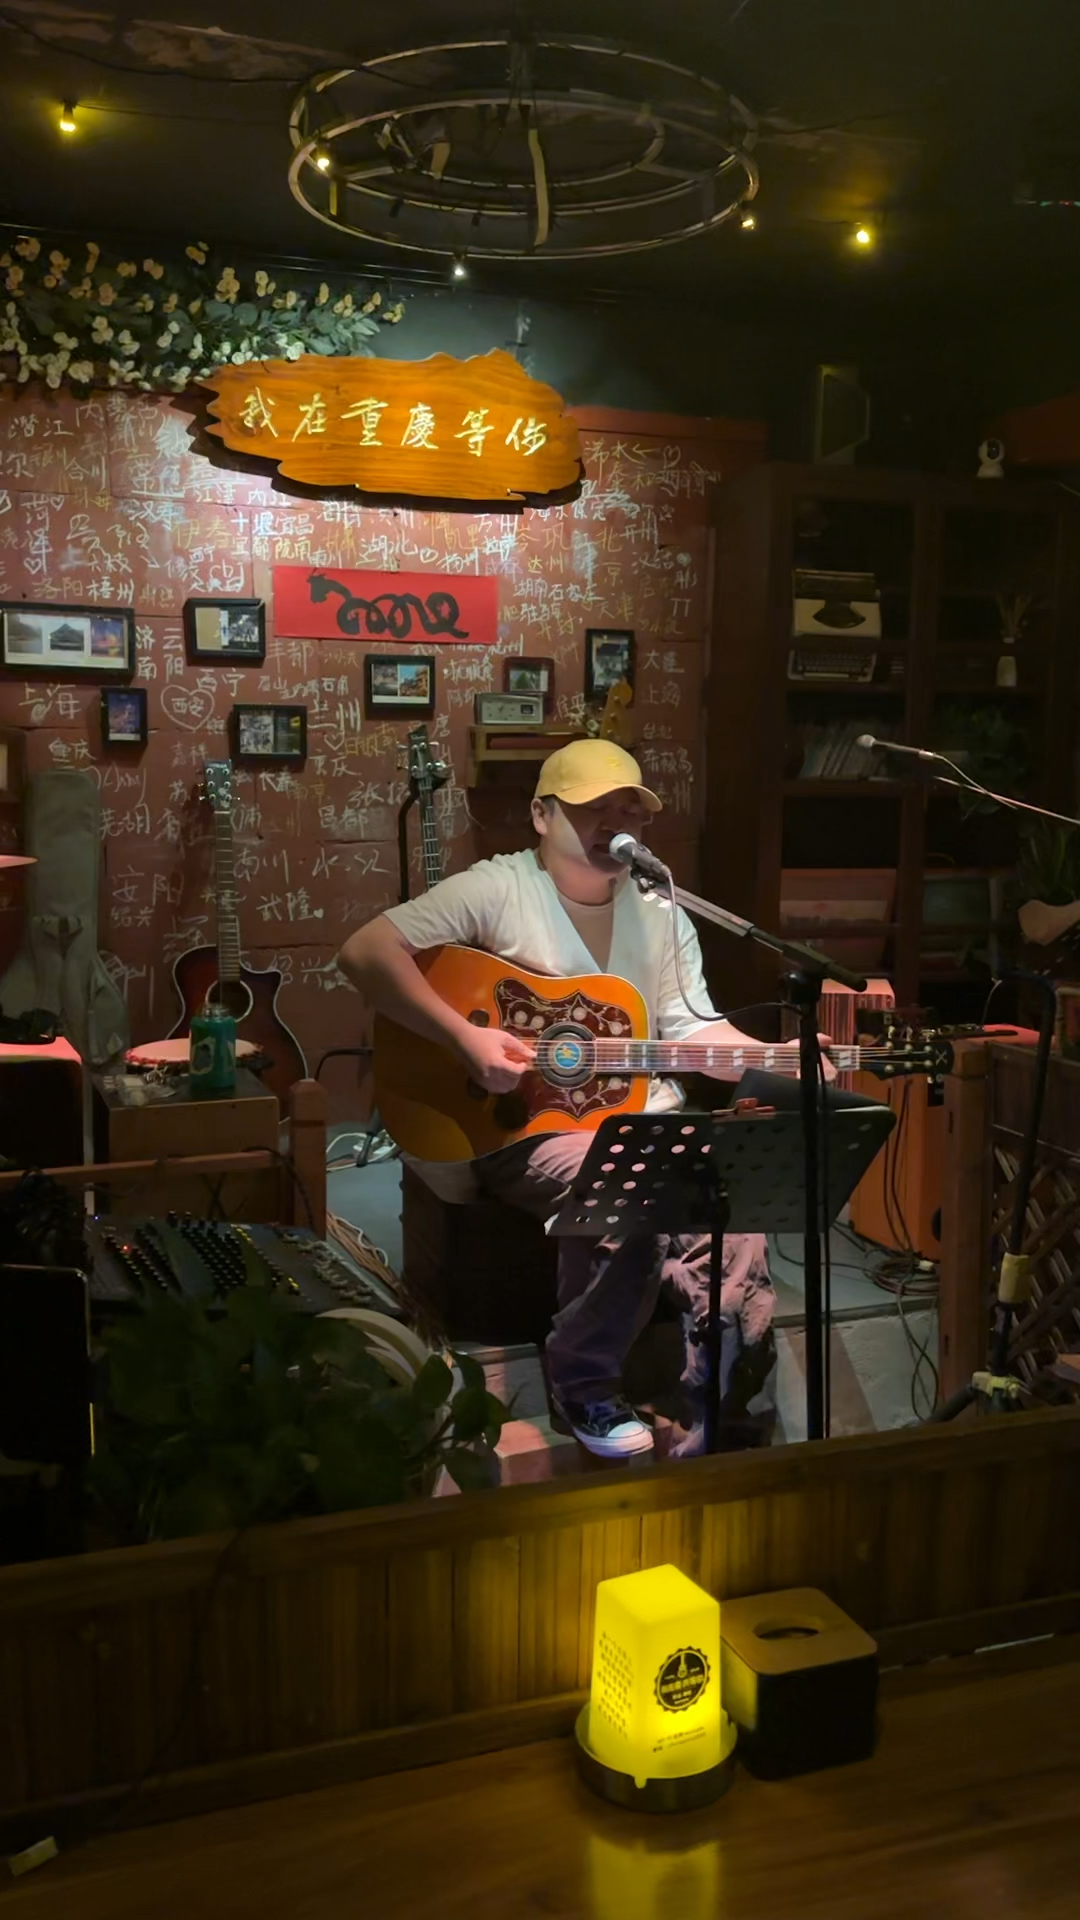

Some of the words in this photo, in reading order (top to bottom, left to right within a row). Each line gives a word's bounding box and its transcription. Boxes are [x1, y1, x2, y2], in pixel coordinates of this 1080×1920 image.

[239, 386, 547, 457] 我在重慶等你
[527, 553, 563, 574] 达州
[135, 625, 158, 681] 济南
[162, 627, 184, 684] 云阳
